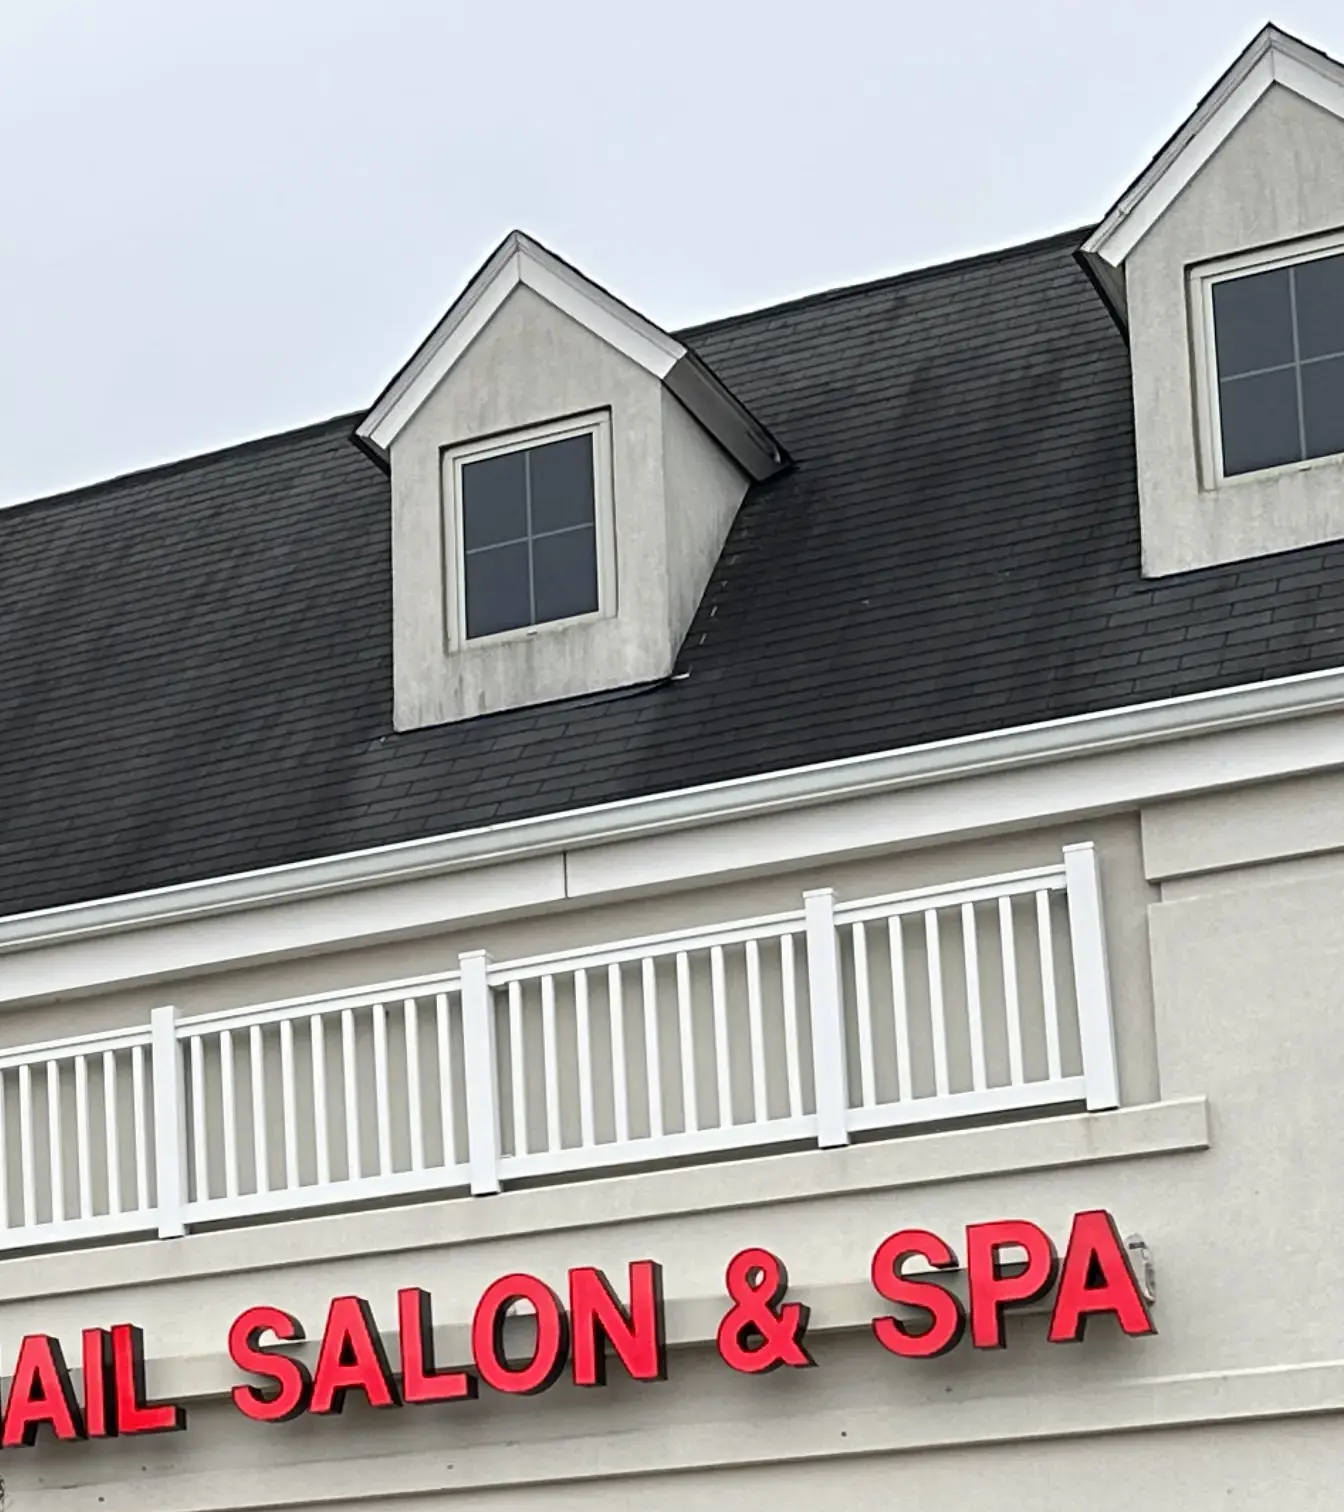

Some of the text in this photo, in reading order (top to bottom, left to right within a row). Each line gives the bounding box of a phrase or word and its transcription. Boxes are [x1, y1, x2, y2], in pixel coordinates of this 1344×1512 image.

[231, 1260, 667, 1422] SALON
[717, 1248, 816, 1374] &
[871, 1210, 1157, 1360] SPA
